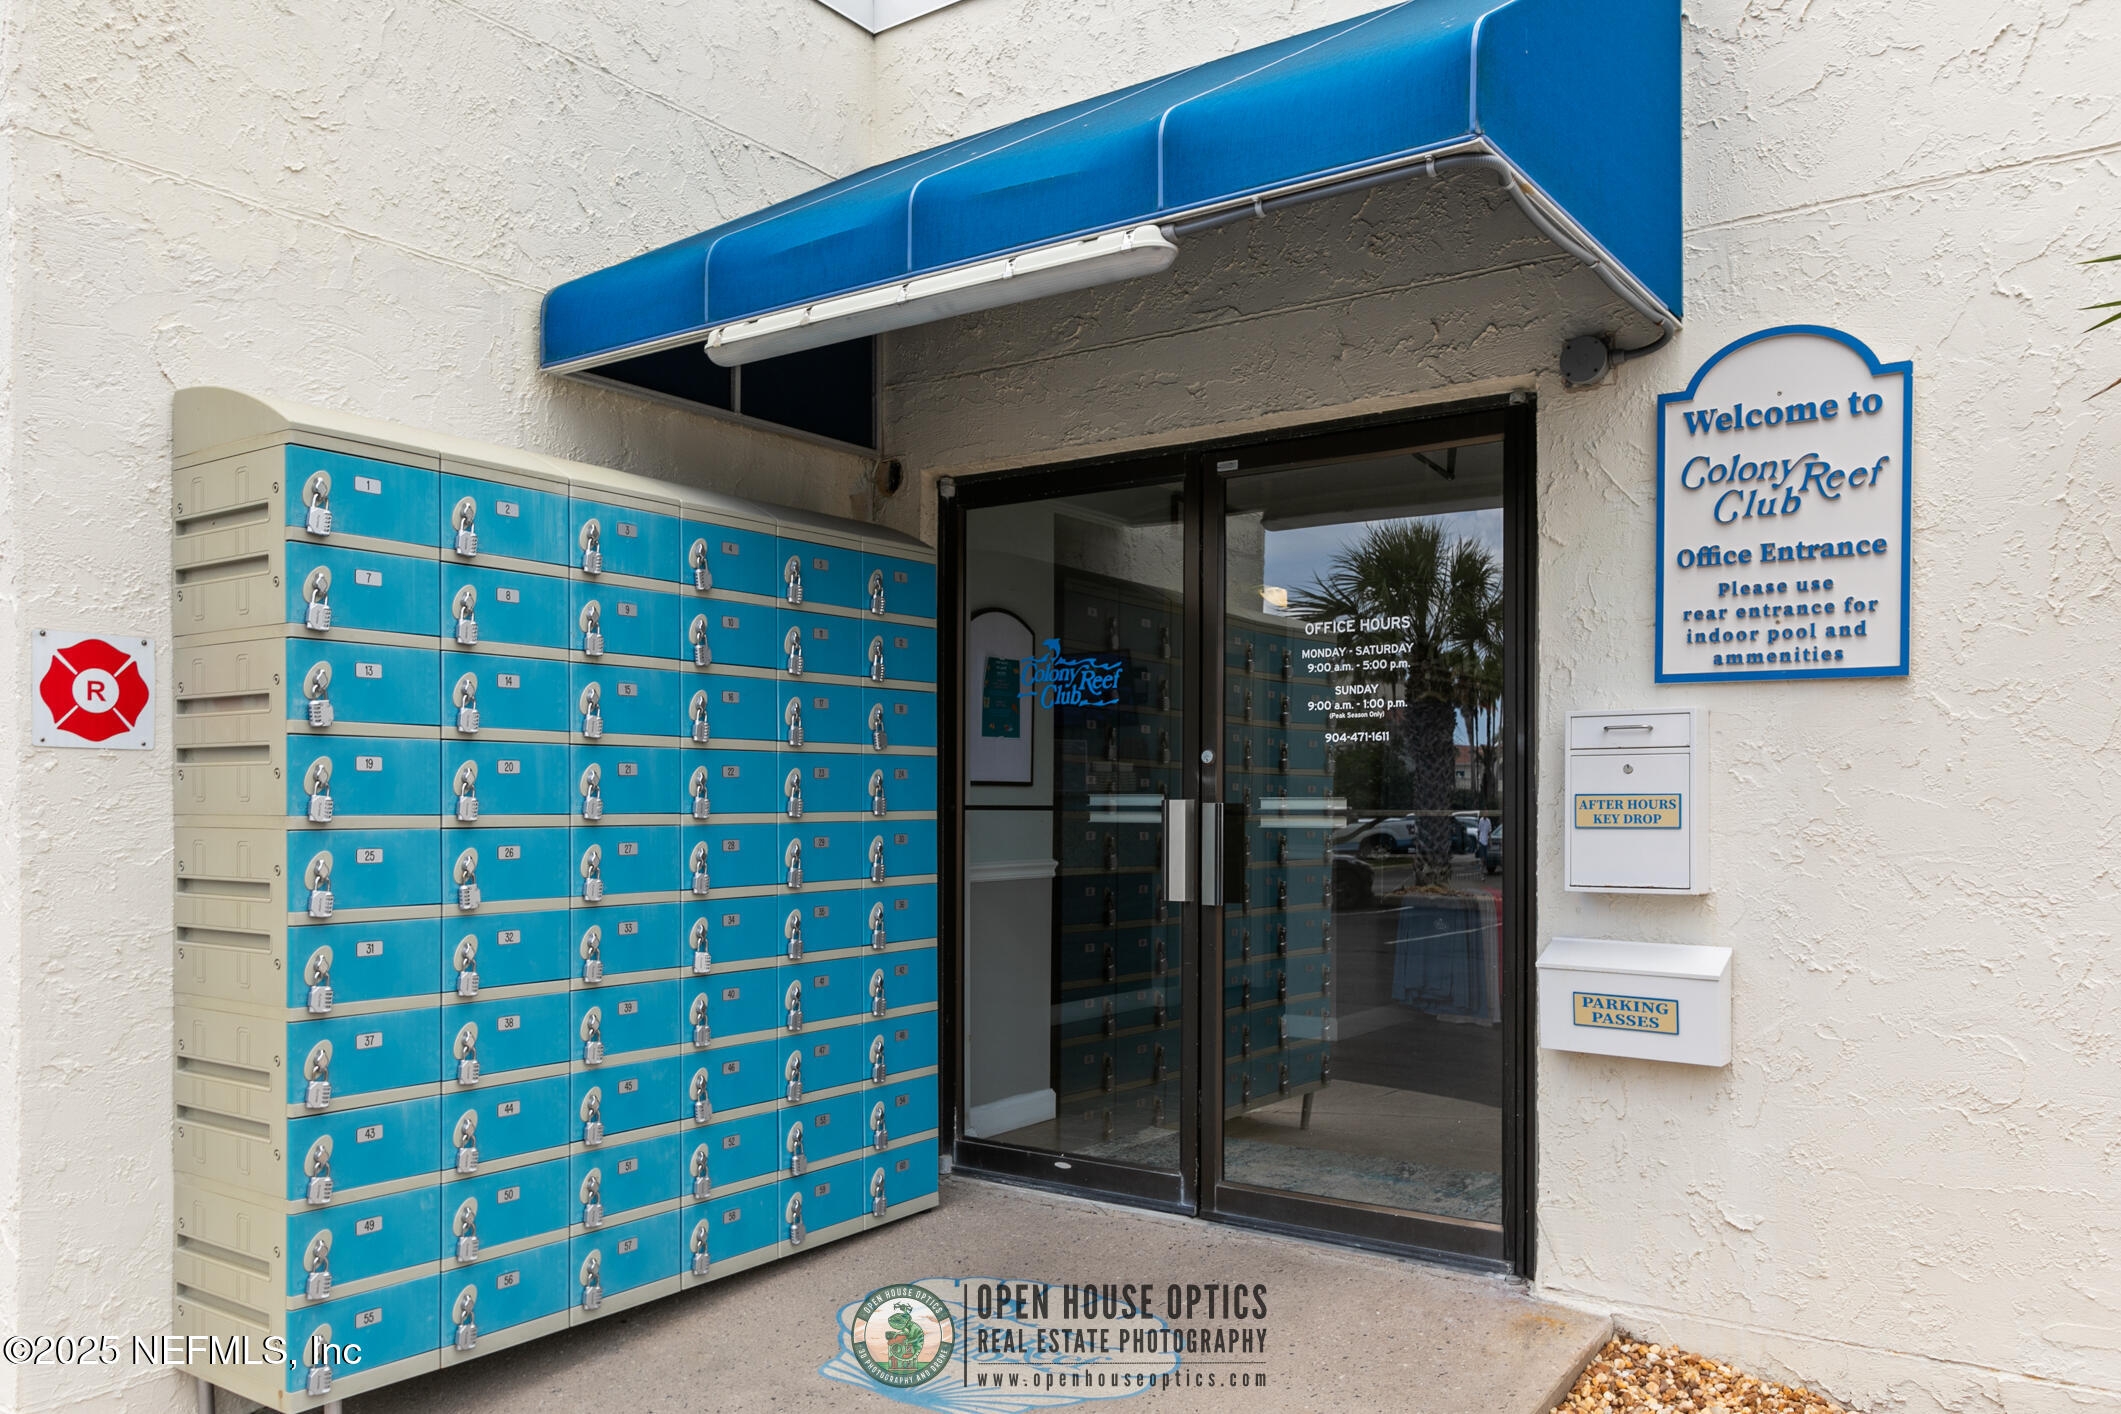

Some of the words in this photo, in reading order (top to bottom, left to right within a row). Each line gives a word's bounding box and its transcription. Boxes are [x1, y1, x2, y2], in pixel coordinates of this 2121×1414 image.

[1683, 399, 1839, 435] Welcome
[1848, 391, 1884, 416] to
[1681, 453, 1819, 490] Colony
[1799, 455, 1890, 499] Reef
[1713, 486, 1802, 524] Club
[1677, 545, 1752, 569] Office
[1760, 537, 1888, 563] Entrance
[1718, 581, 1788, 598] Please
[1796, 578, 1834, 592] use
[1683, 607, 1728, 622] rear
[1736, 601, 1836, 618] entrance
[1844, 596, 1879, 613] for
[1305, 620, 1356, 635] OFFICE
[1360, 616, 1411, 632] HOURS
[1686, 627, 1759, 644] indoor
[1768, 622, 1816, 644] pool
[1825, 620, 1867, 638] and
[1301, 647, 1347, 659] MONDAY
[1355, 643, 1414, 655] SATURDAY
[1713, 646, 1844, 666] ammenities
[365, 665, 374, 676] 13
[1307, 663, 1331, 673] 9:00
[1334, 664, 1354, 672] a.m.
[1363, 660, 1387, 670] 5:00
[1390, 660, 1411, 671] p.m.
[505, 676, 513, 686] 14
[1021, 663, 1090, 688] Colony
[1079, 668, 1123, 695] Reef
[87, 681, 106, 701] R
[624, 685, 631, 695] 15
[1335, 684, 1379, 695] SUNDAY
[1041, 684, 1081, 709] Club
[1307, 701, 1331, 711] 9:00
[1334, 702, 1354, 710] a.m.
[1363, 699, 1384, 708] 1:00
[1387, 699, 1408, 710] p.m.
[1369, 711, 1385, 719] Only)
[1325, 731, 1390, 743] 904-471-1611
[365, 758, 374, 769] 19
[504, 761, 514, 772] 20
[625, 764, 632, 775] 21
[1578, 800, 1624, 810] AFTER
[1627, 799, 1677, 810] HOURS
[1593, 814, 1620, 824] KEY
[1623, 814, 1662, 824] DROP
[504, 847, 514, 858] 26
[624, 844, 633, 854] 27
[364, 850, 375, 862] 25
[624, 923, 633, 933] 33
[504, 932, 514, 943] 32
[366, 943, 374, 954] 31
[624, 1002, 633, 1013] 39
[1582, 996, 1669, 1015] PARKING
[504, 1017, 514, 1028] 38
[1592, 1012, 1660, 1028] PASSES
[364, 1035, 375, 1047] 37
[624, 1081, 633, 1091] 45
[504, 1103, 514, 1113] 44
[364, 1127, 376, 1139] 43
[625, 1161, 632, 1171] 51
[504, 1189, 514, 1201] 50
[364, 1219, 375, 1231] 49
[624, 1240, 632, 1251] 57
[504, 1274, 514, 1286] 56
[363, 1311, 375, 1325] 55
